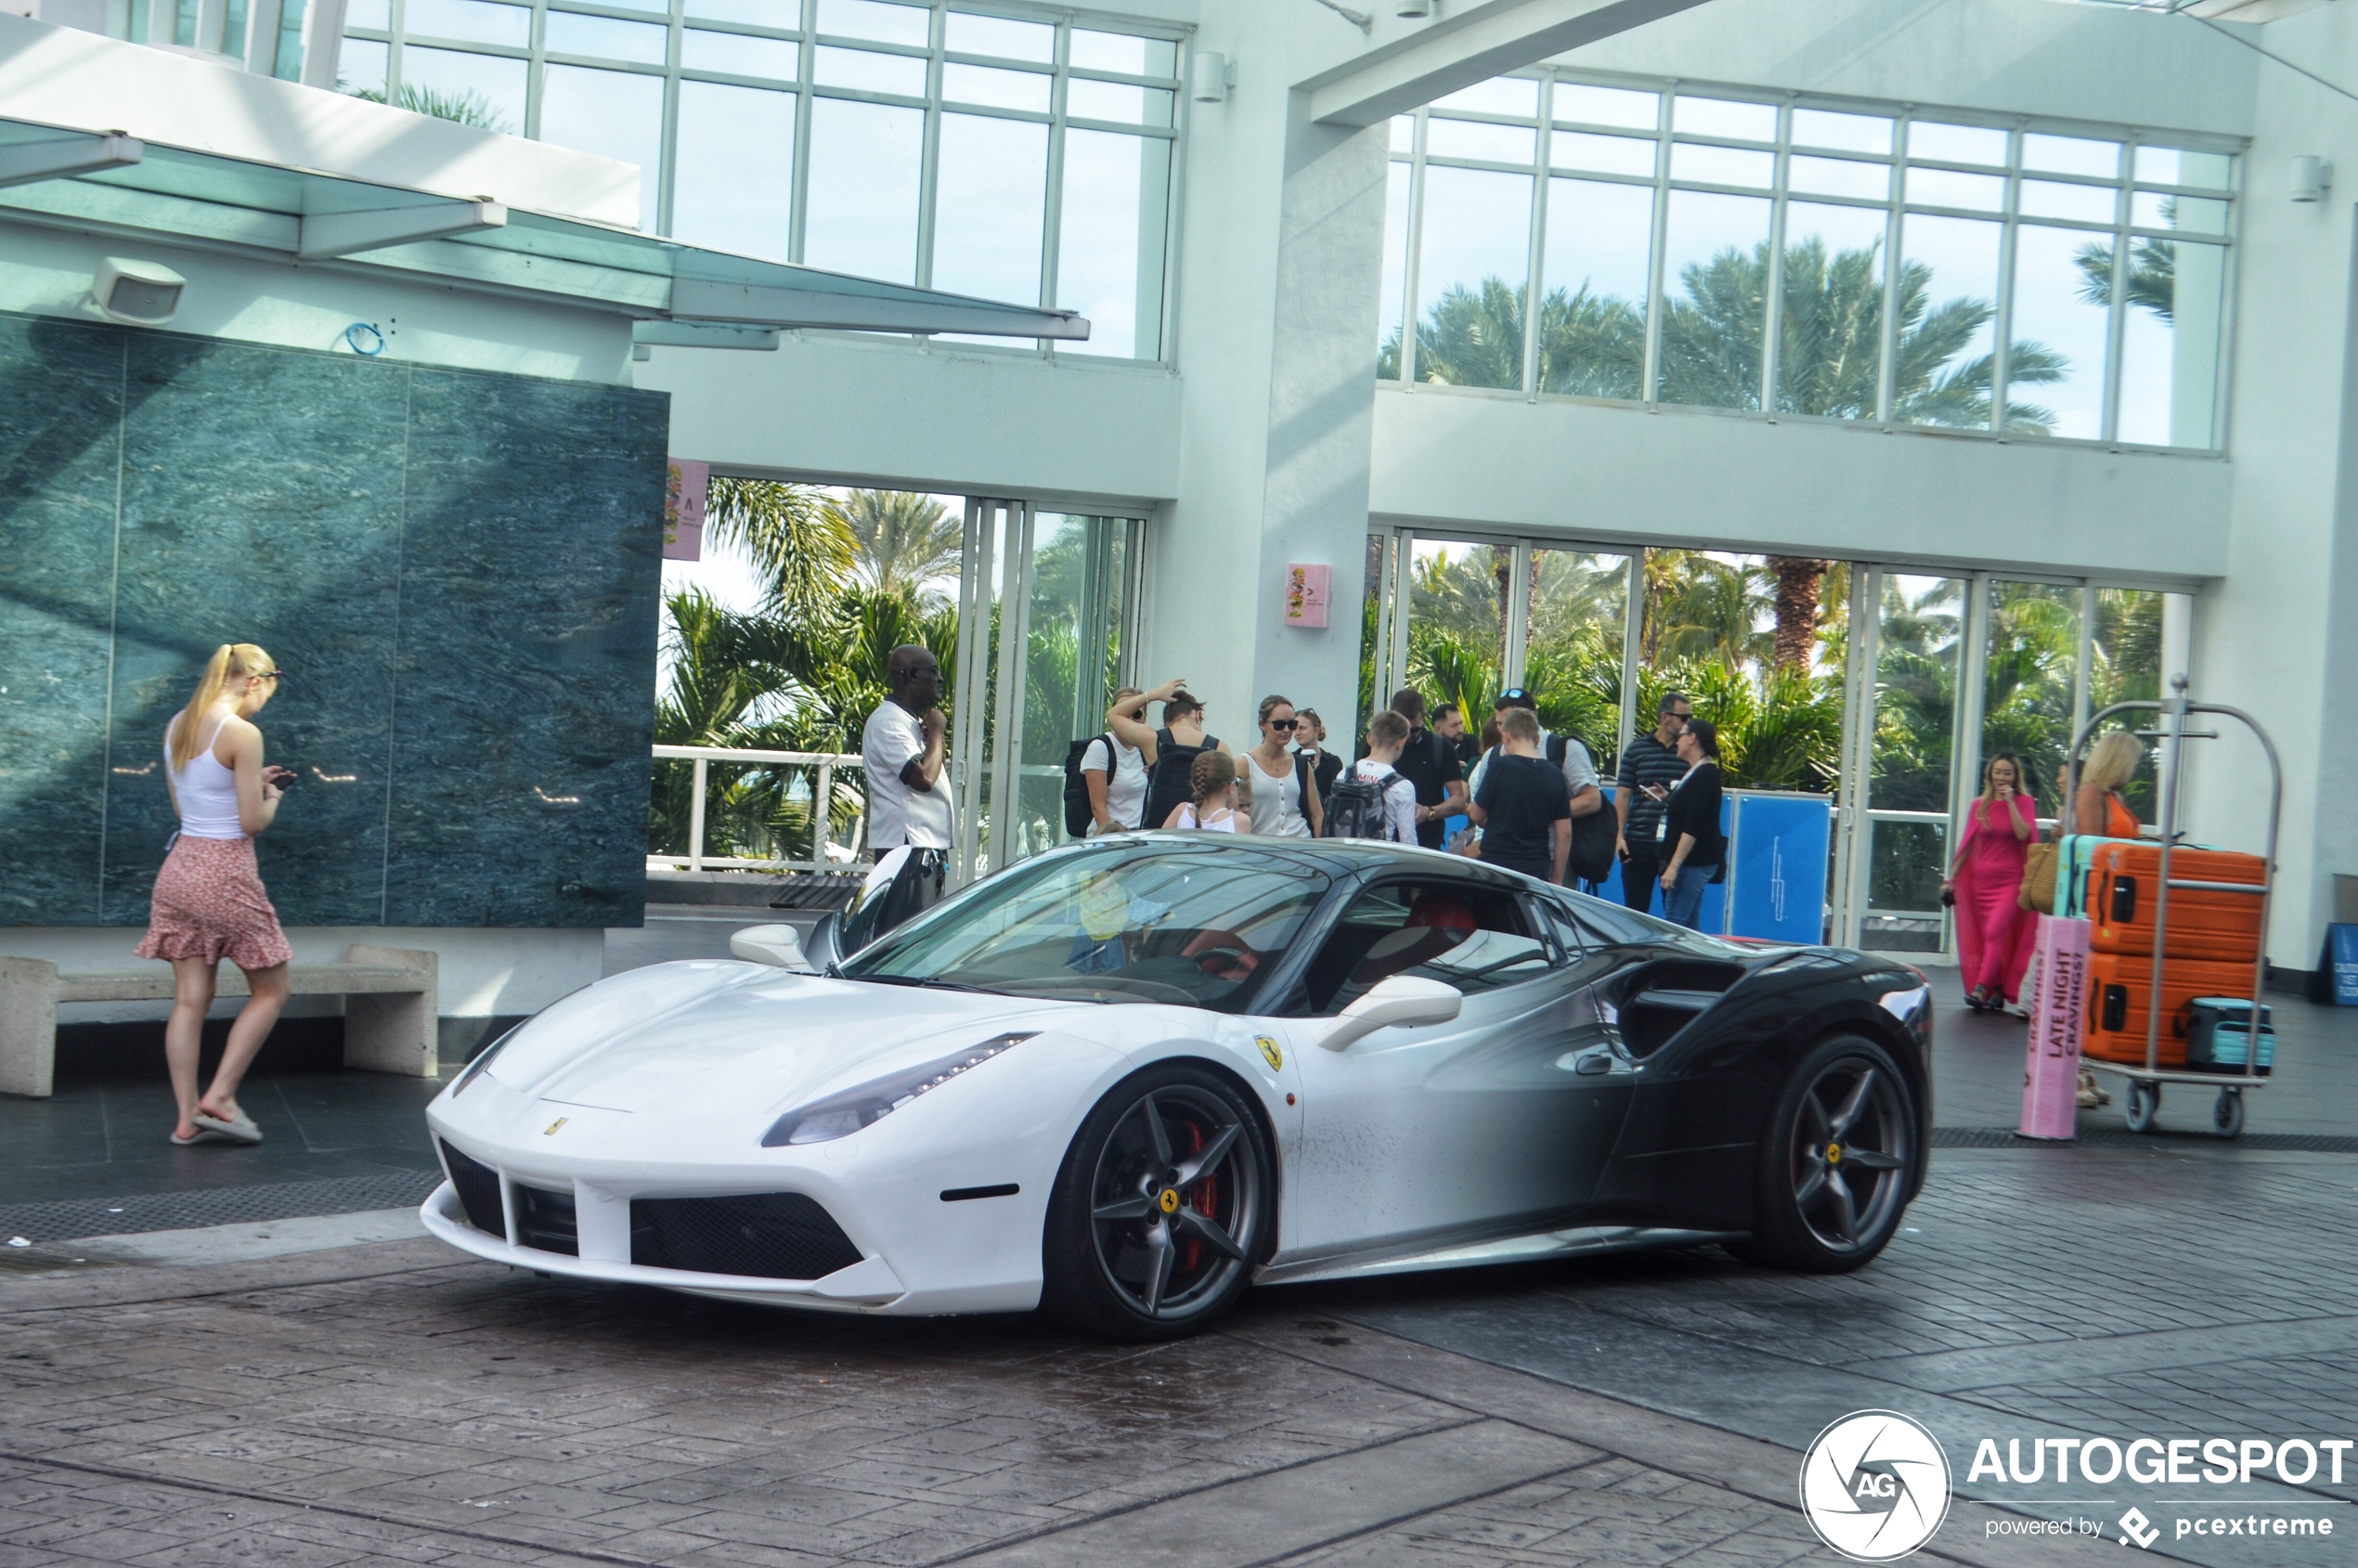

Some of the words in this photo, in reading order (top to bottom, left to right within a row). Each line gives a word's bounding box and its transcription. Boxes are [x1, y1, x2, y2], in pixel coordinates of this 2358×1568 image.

[2053, 948, 2072, 1008] NIGHT
[2066, 952, 2084, 1057] CRAVINGS?
[2048, 1014, 2065, 1058] LATE
